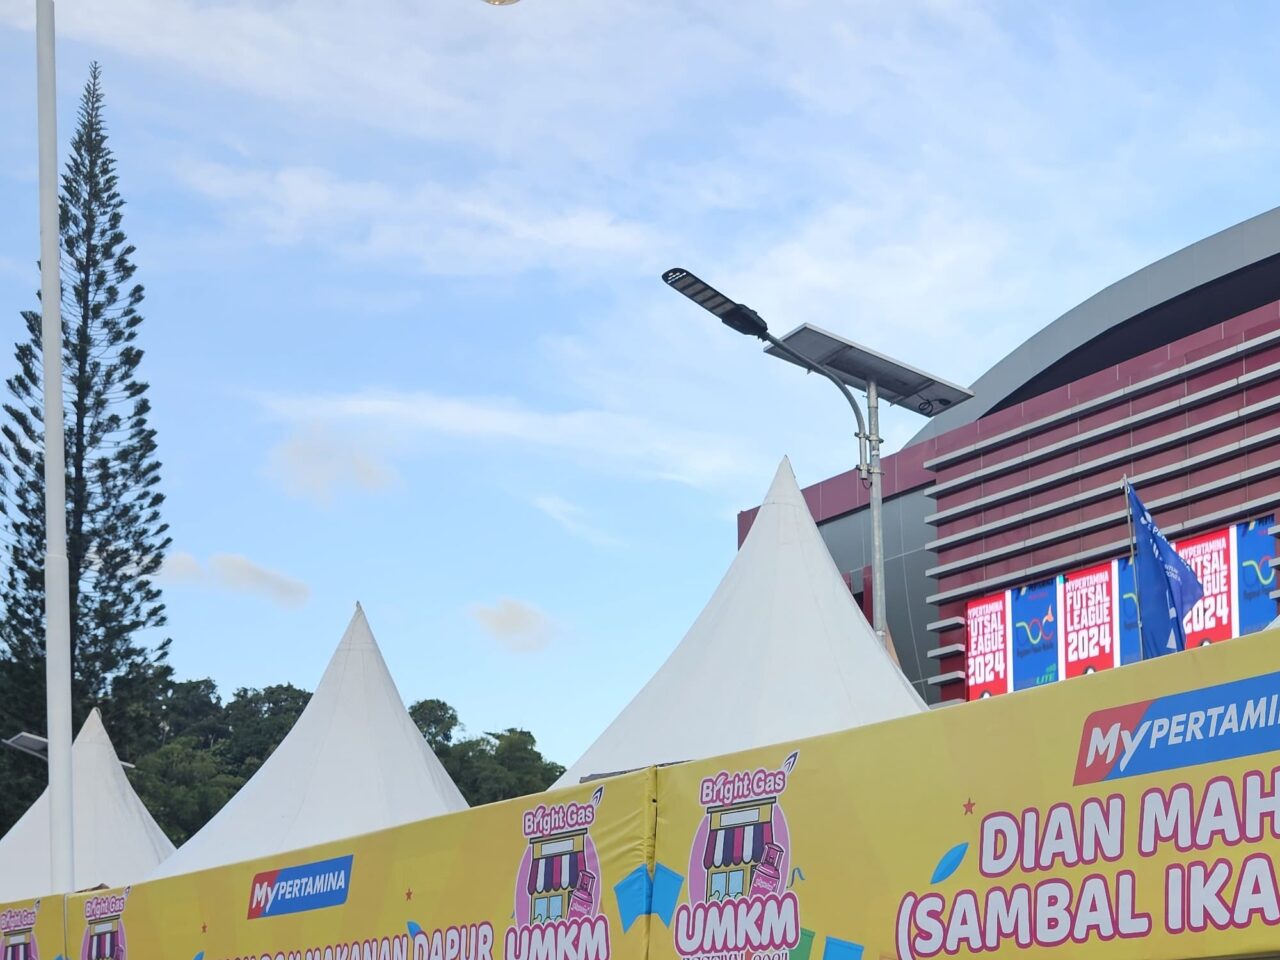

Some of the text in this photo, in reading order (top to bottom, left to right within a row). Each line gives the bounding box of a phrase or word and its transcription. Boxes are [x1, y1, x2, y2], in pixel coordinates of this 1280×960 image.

[1066, 582, 1110, 612] FUTSAL
[1067, 603, 1110, 632] LEAGUE
[1068, 623, 1112, 662] 2024
[968, 650, 1005, 686] 2024
[702, 770, 785, 803] Bright Gas
[525, 803, 594, 835] Bright Gas
[980, 795, 1124, 876] DIAN
[109, 896, 125, 913] Gas
[675, 893, 799, 954] UMKM
